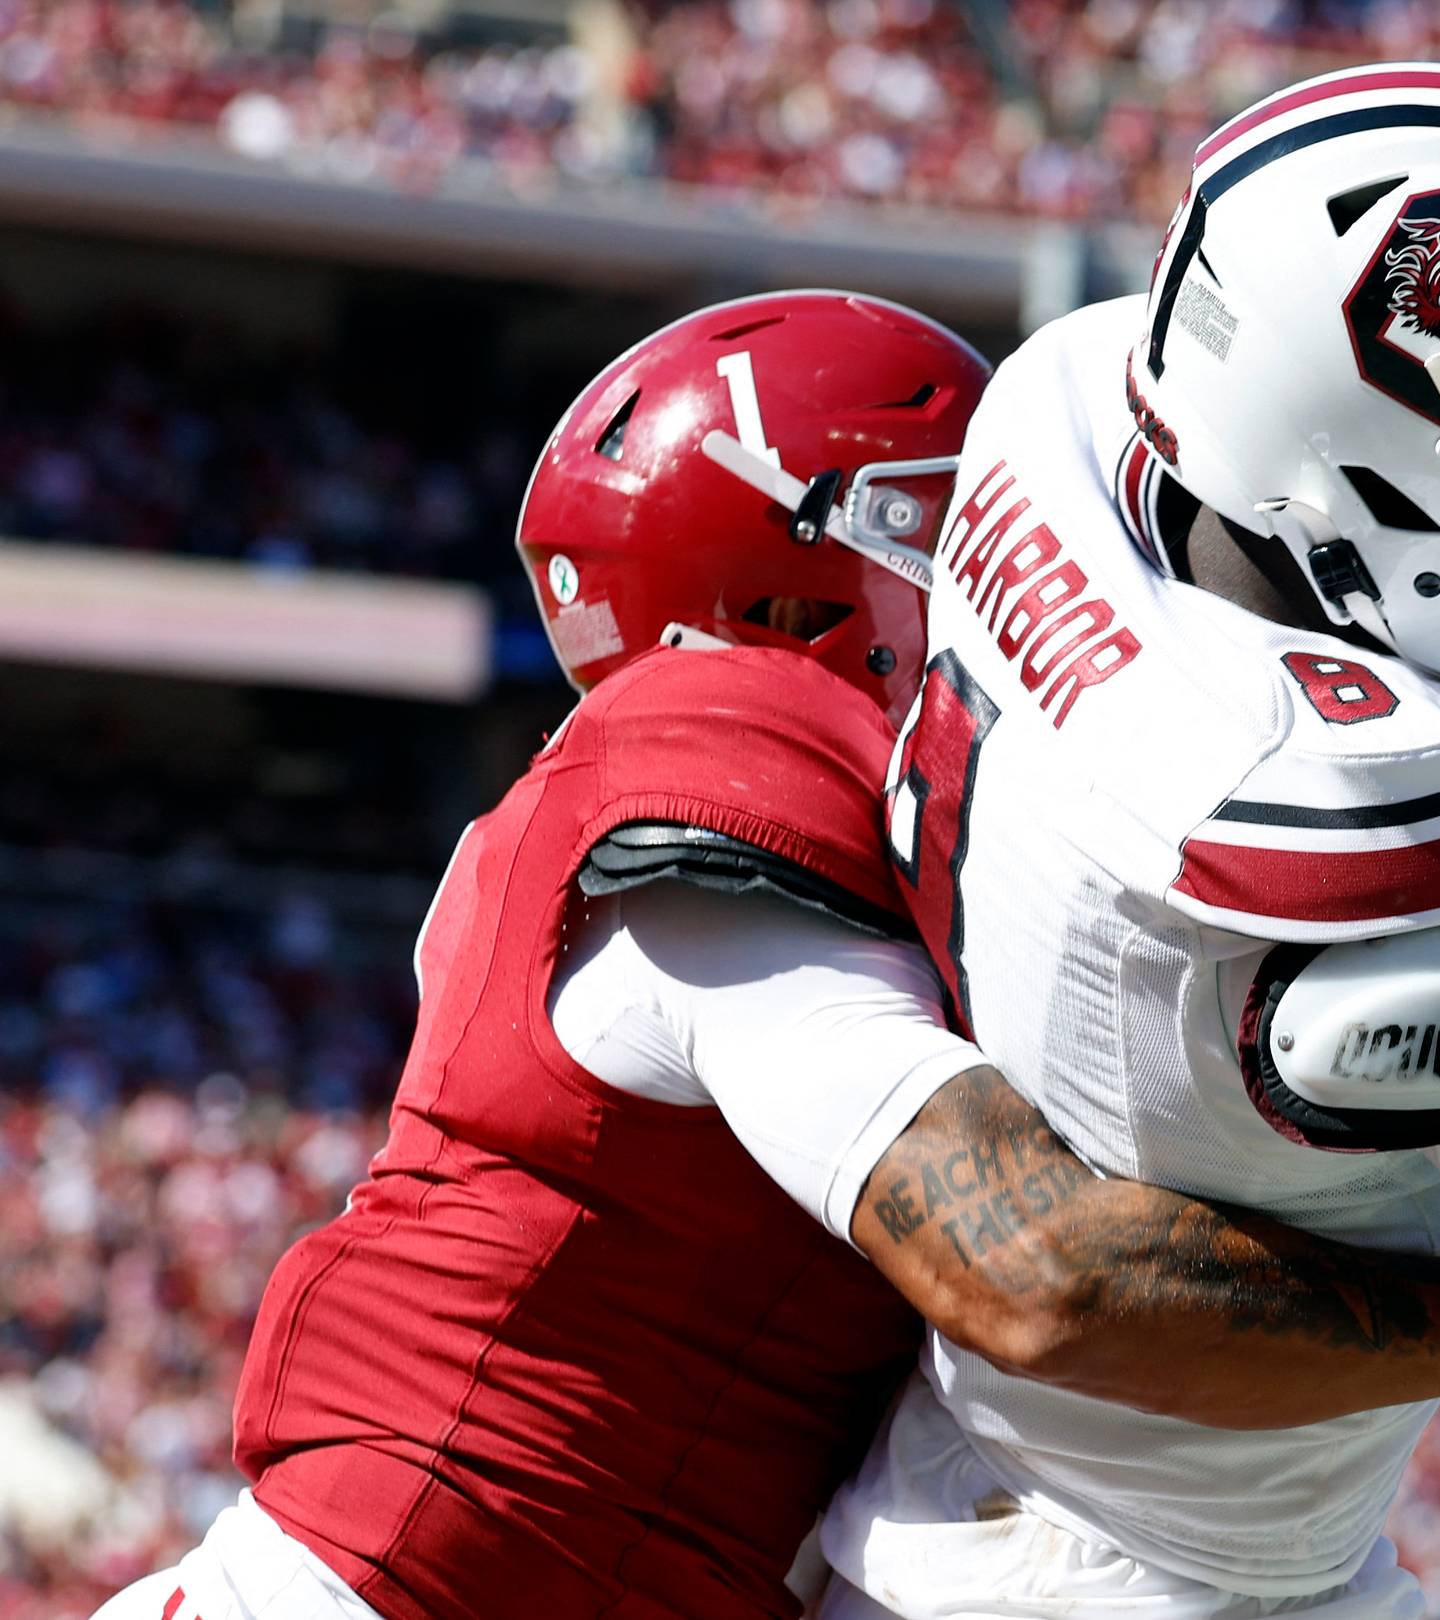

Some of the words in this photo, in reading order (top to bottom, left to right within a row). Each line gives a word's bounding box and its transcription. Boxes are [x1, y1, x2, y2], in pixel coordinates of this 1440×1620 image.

[716, 350, 782, 470] 1
[941, 459, 1143, 731] HARBOR
[1280, 651, 1400, 725] 8
[874, 1136, 1005, 1246] REACH
[941, 1187, 1026, 1271] THE
